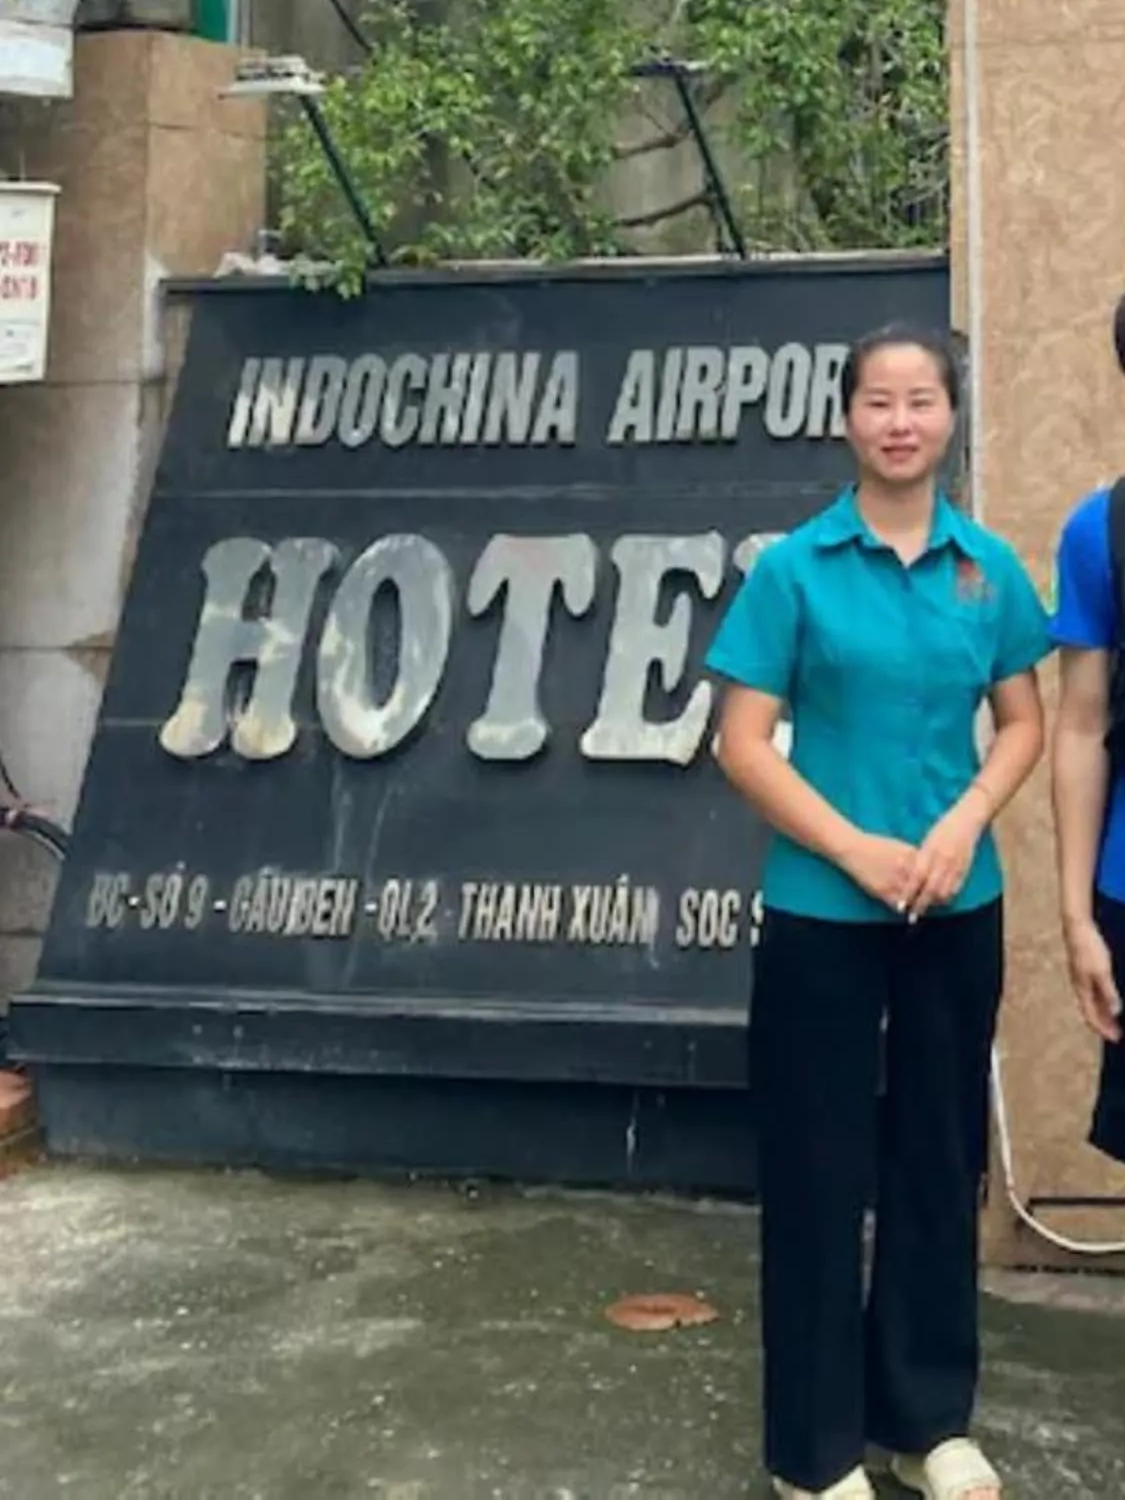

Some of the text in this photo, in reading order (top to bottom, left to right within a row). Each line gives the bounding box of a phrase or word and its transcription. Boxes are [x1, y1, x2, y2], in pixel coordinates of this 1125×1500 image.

[227, 342, 851, 447] INDOCHINA AIRPOR
[159, 532, 793, 766] HOTE
[457, 882, 563, 941] THANH
